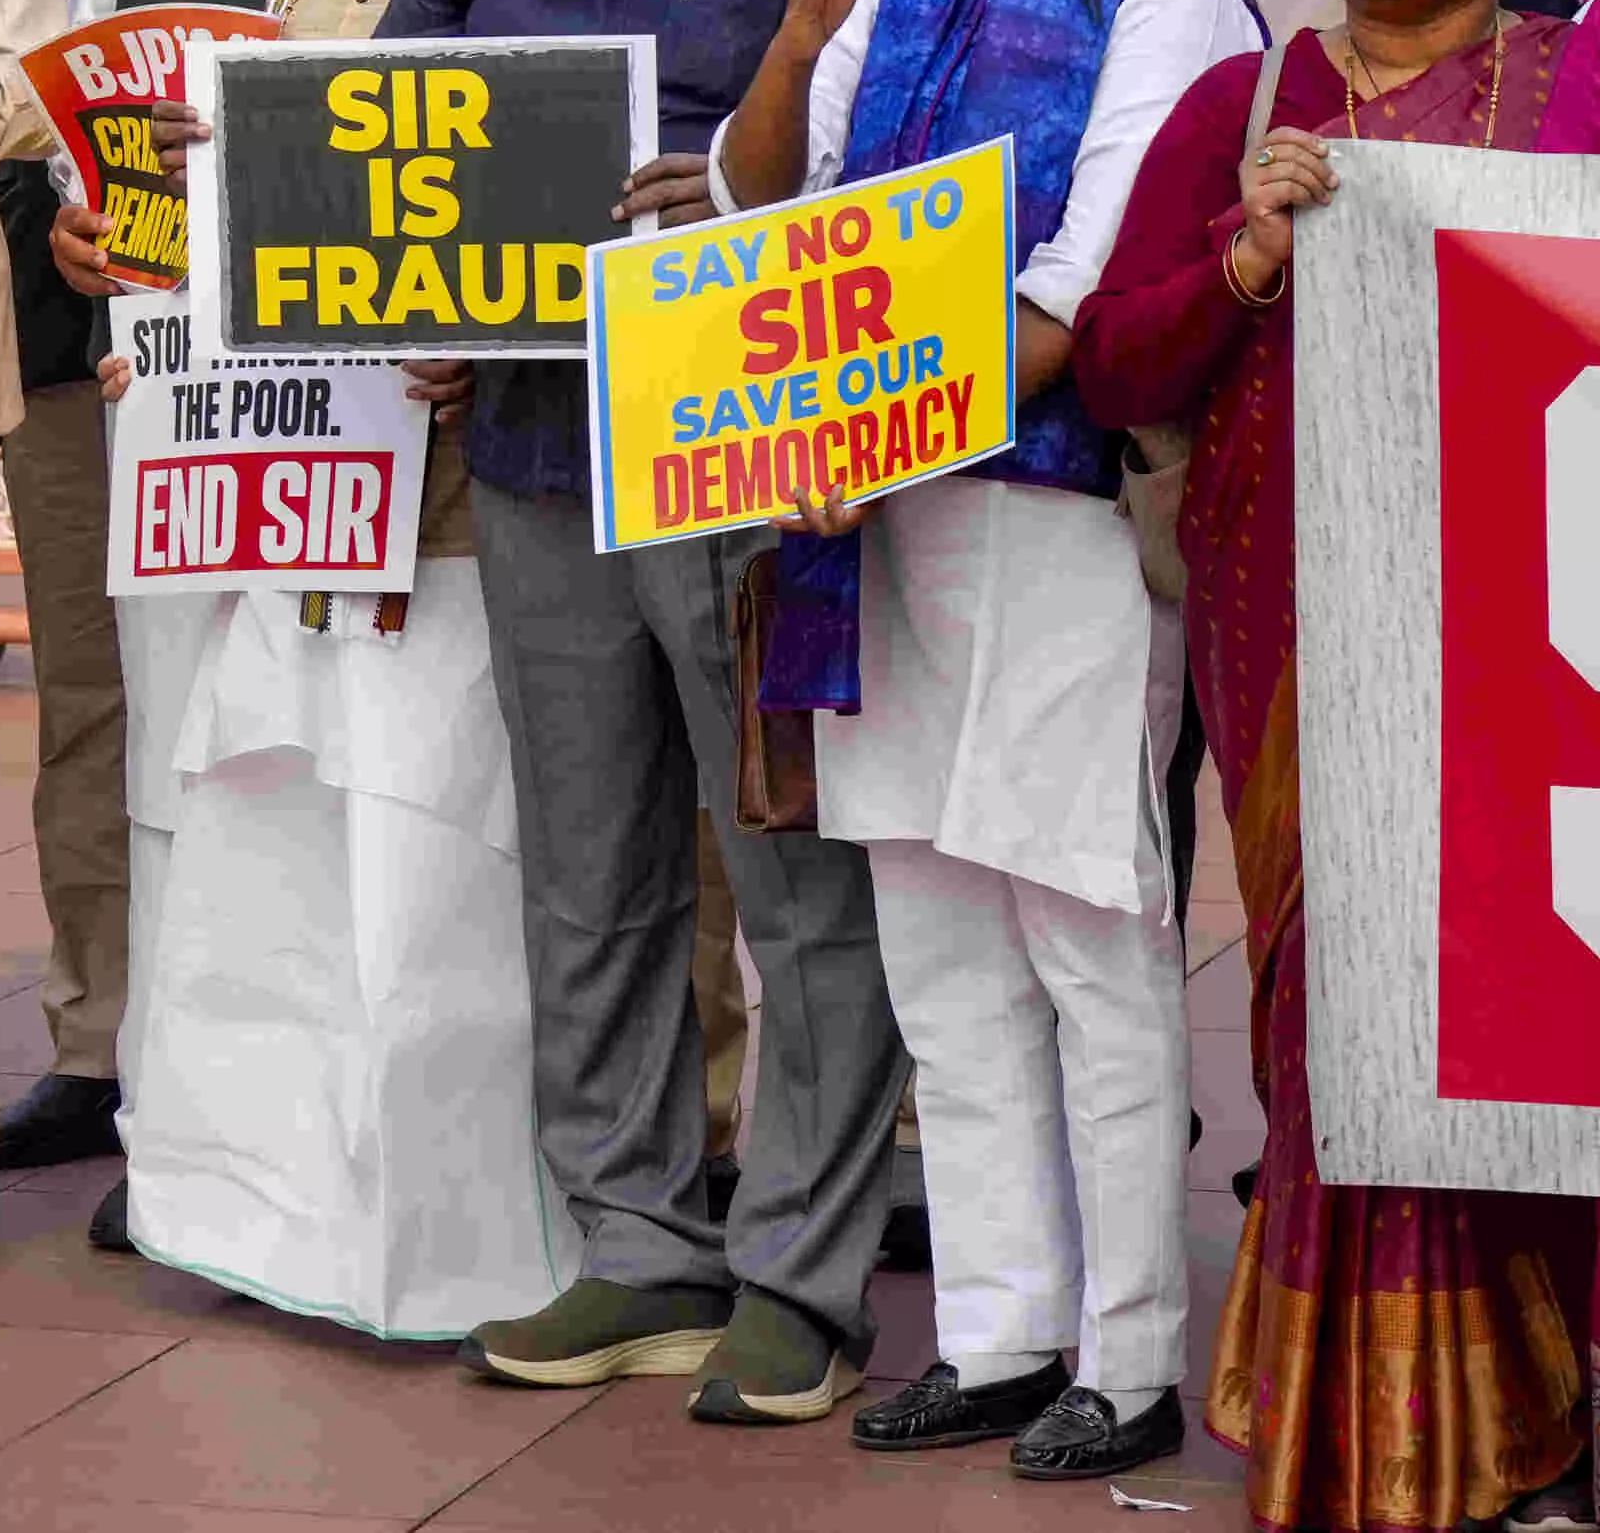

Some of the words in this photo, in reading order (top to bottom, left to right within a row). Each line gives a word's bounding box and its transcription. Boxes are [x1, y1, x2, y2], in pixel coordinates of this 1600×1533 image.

[327, 68, 493, 152] SIR
[368, 155, 461, 238] IS
[651, 231, 768, 302] SAY
[786, 206, 872, 271] NO
[887, 178, 963, 240] TO
[254, 243, 588, 327] FRAUD
[739, 265, 895, 375] SIR
[173, 381, 221, 443] THE
[231, 378, 341, 439] POOR.
[672, 371, 821, 444] SAVE
[837, 334, 945, 407] OUR
[652, 373, 975, 530] DEMOCRACY
[140, 463, 239, 570] END
[258, 460, 382, 564] SIR
